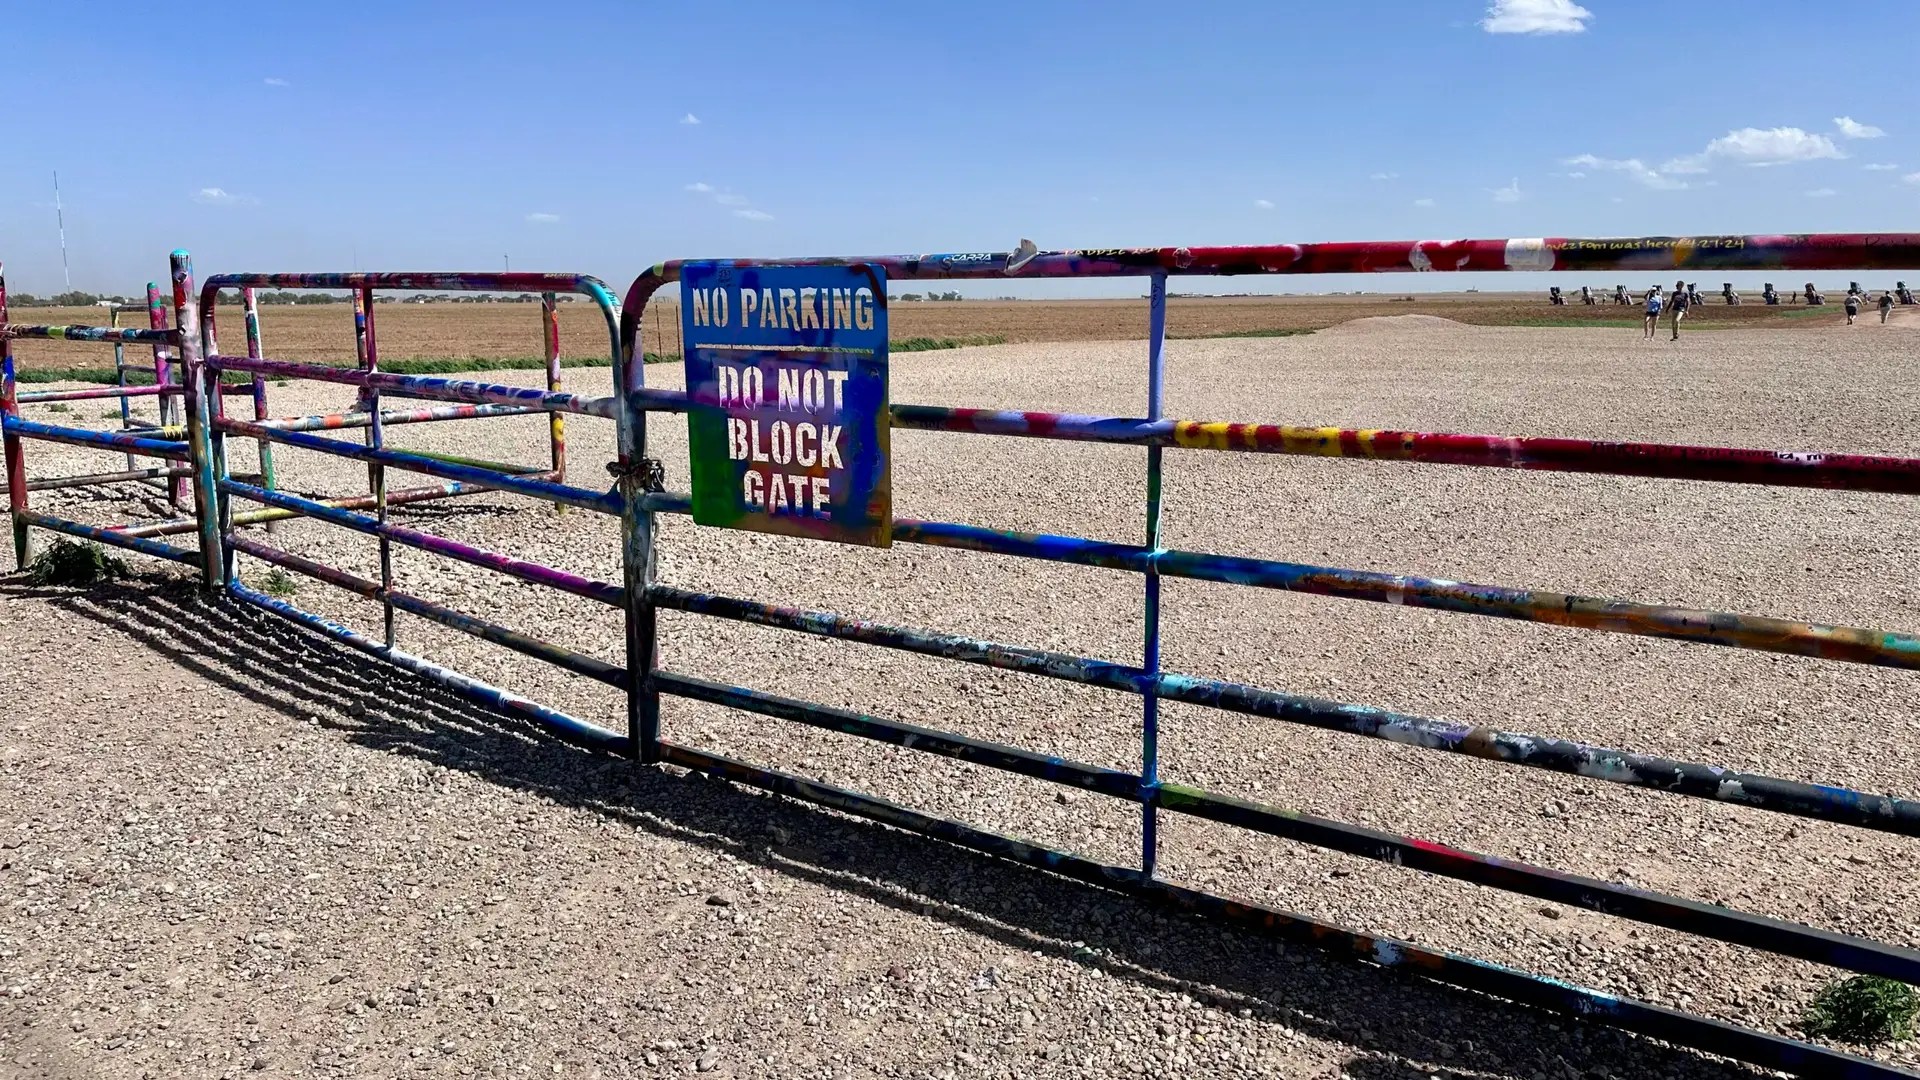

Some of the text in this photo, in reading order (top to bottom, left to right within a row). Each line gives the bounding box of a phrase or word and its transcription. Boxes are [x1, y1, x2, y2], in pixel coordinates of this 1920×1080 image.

[1610, 240, 1641, 250] was
[692, 286, 874, 332] NO PARKING
[718, 365, 849, 415] DO NOT
[727, 417, 844, 470] BLOCK
[743, 469, 832, 521] GATE
